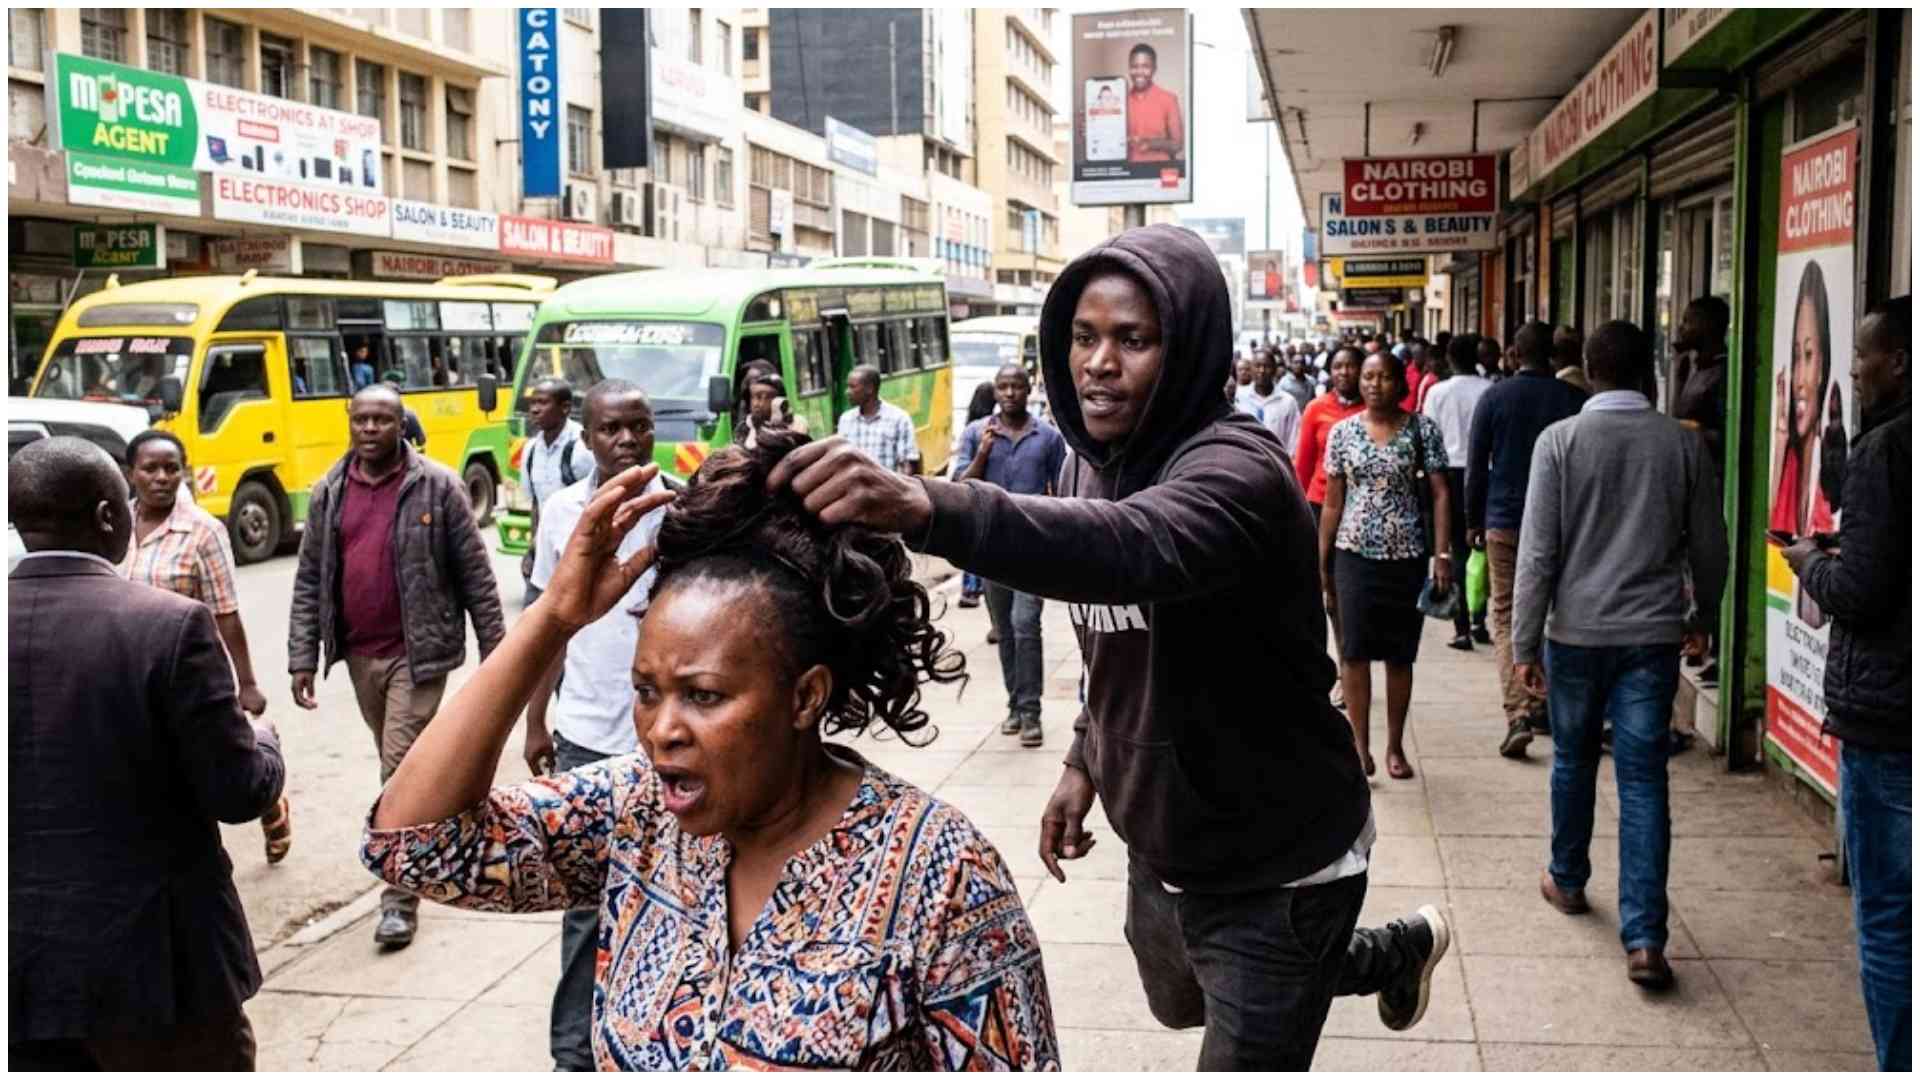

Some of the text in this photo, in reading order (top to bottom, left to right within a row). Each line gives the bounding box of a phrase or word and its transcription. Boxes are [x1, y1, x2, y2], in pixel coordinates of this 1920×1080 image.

[526, 9, 552, 139] CATONY
[205, 89, 314, 127] ELECTRONICS
[92, 122, 169, 155] AGENT
[1363, 159, 1475, 181] NAIROBI
[1792, 145, 1848, 198] NAIROBI
[219, 178, 341, 214] ELECTRONICS
[344, 196, 387, 220] SHOP
[1351, 179, 1487, 202] CLOTHING
[394, 203, 496, 233] SALON & BEAUTY
[1403, 217, 1417, 234] &
[1424, 215, 1493, 234] BEAUTY
[502, 219, 548, 252] SALON
[562, 227, 611, 259] BEAUTY
